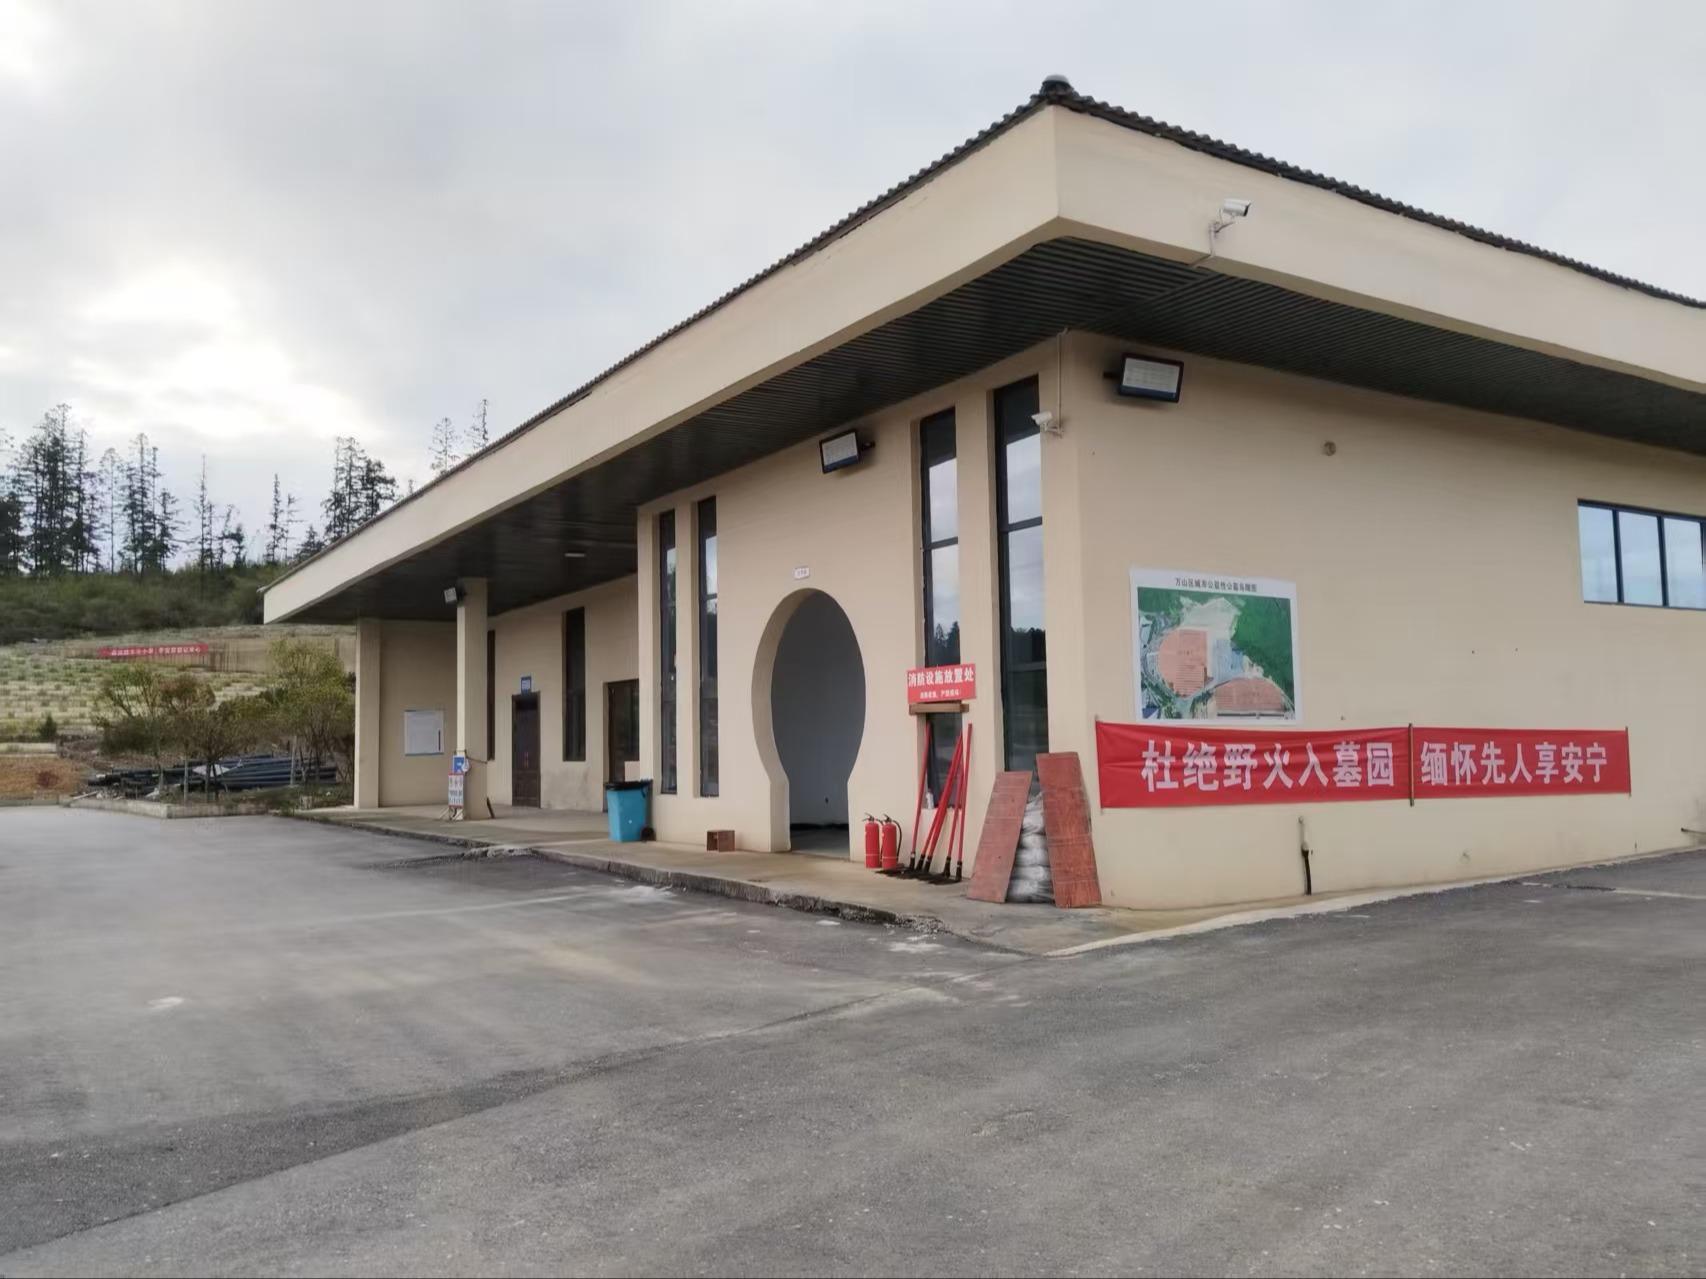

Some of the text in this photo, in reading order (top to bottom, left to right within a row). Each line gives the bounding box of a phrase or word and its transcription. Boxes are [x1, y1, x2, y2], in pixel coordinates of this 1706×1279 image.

[908, 667, 974, 688] 消防设施放置处
[1141, 740, 1607, 792] 杜绝野火入墓园 缅怀先人享安宁
